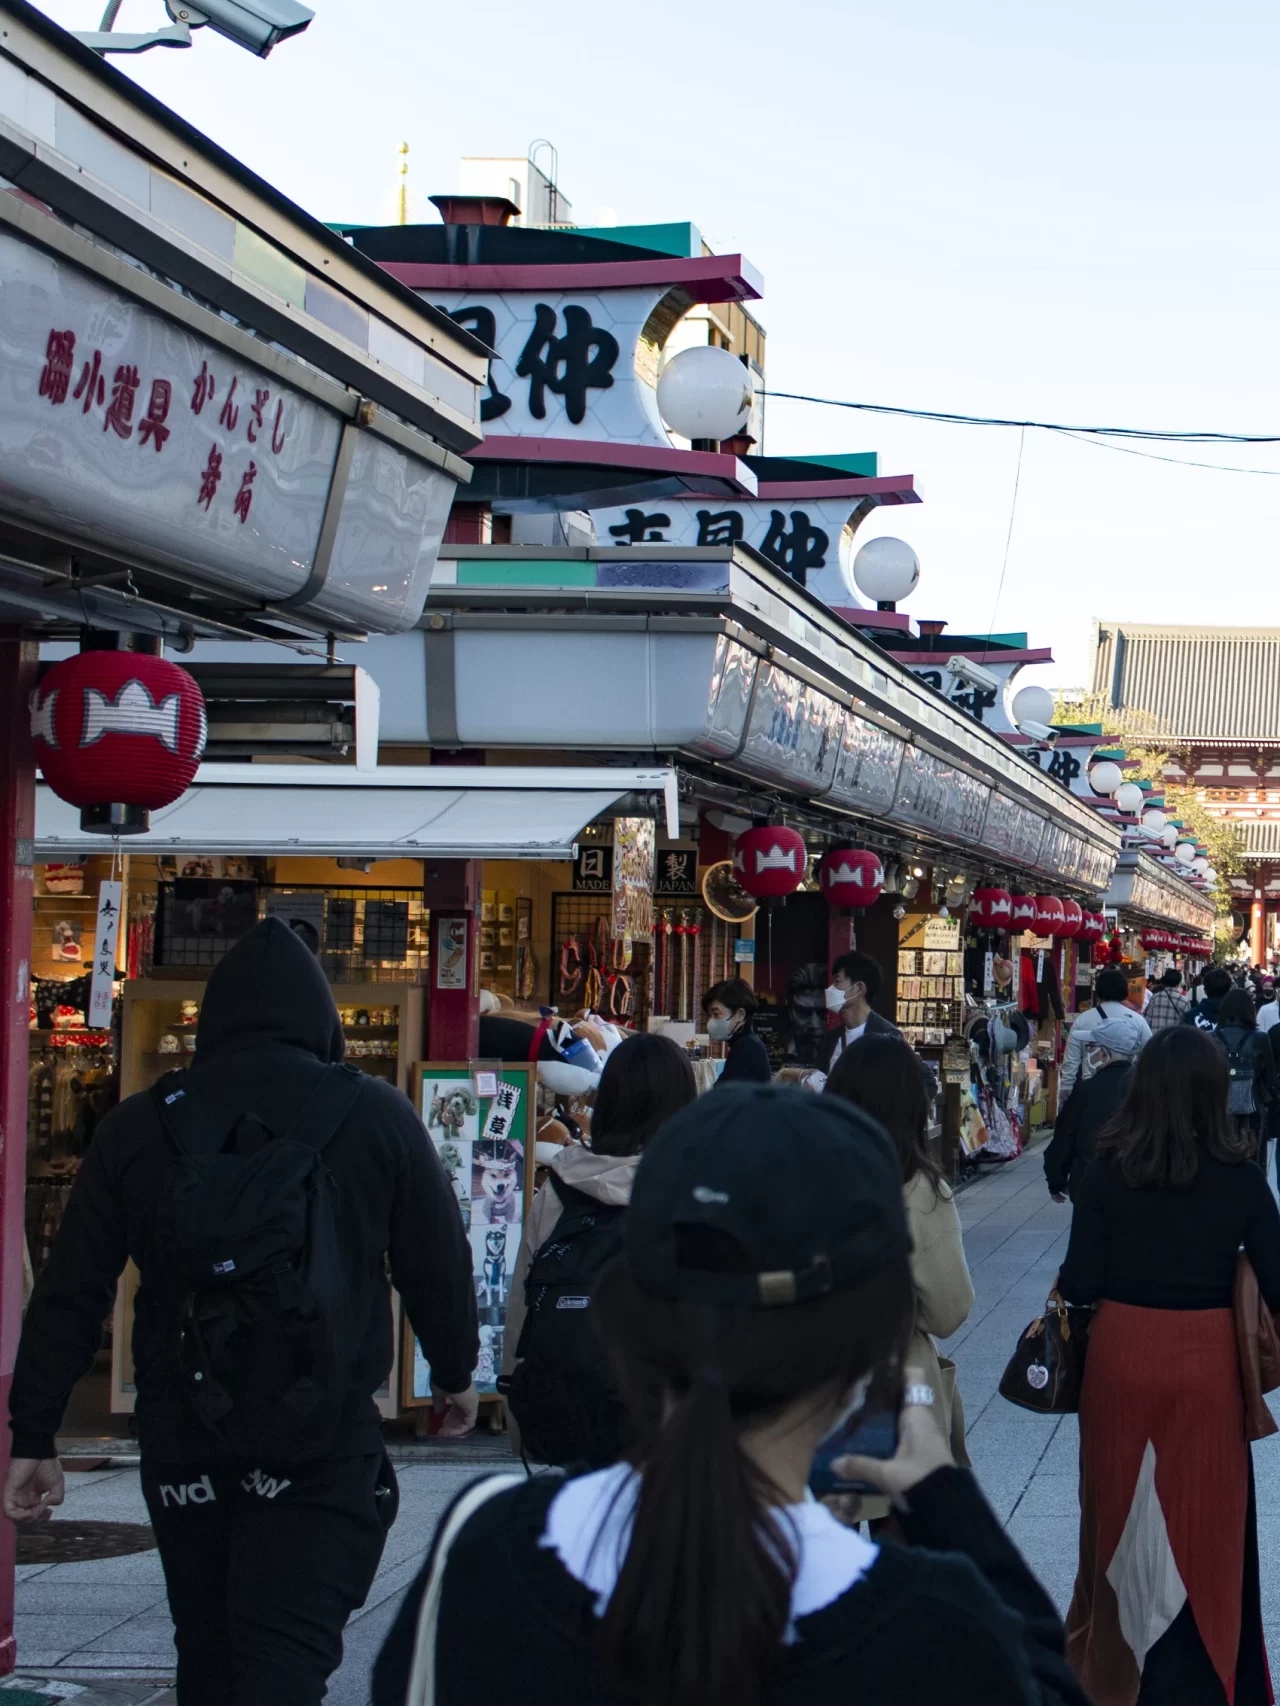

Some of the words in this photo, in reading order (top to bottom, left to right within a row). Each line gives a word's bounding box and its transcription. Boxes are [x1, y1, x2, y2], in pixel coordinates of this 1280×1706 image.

[191, 360, 286, 455] かんざし
[580, 849, 604, 878] 日
[664, 852, 688, 880] 製
[576, 880, 610, 890] MADE
[657, 880, 695, 891] JAPAN
[489, 1088, 514, 1136] 浅草
